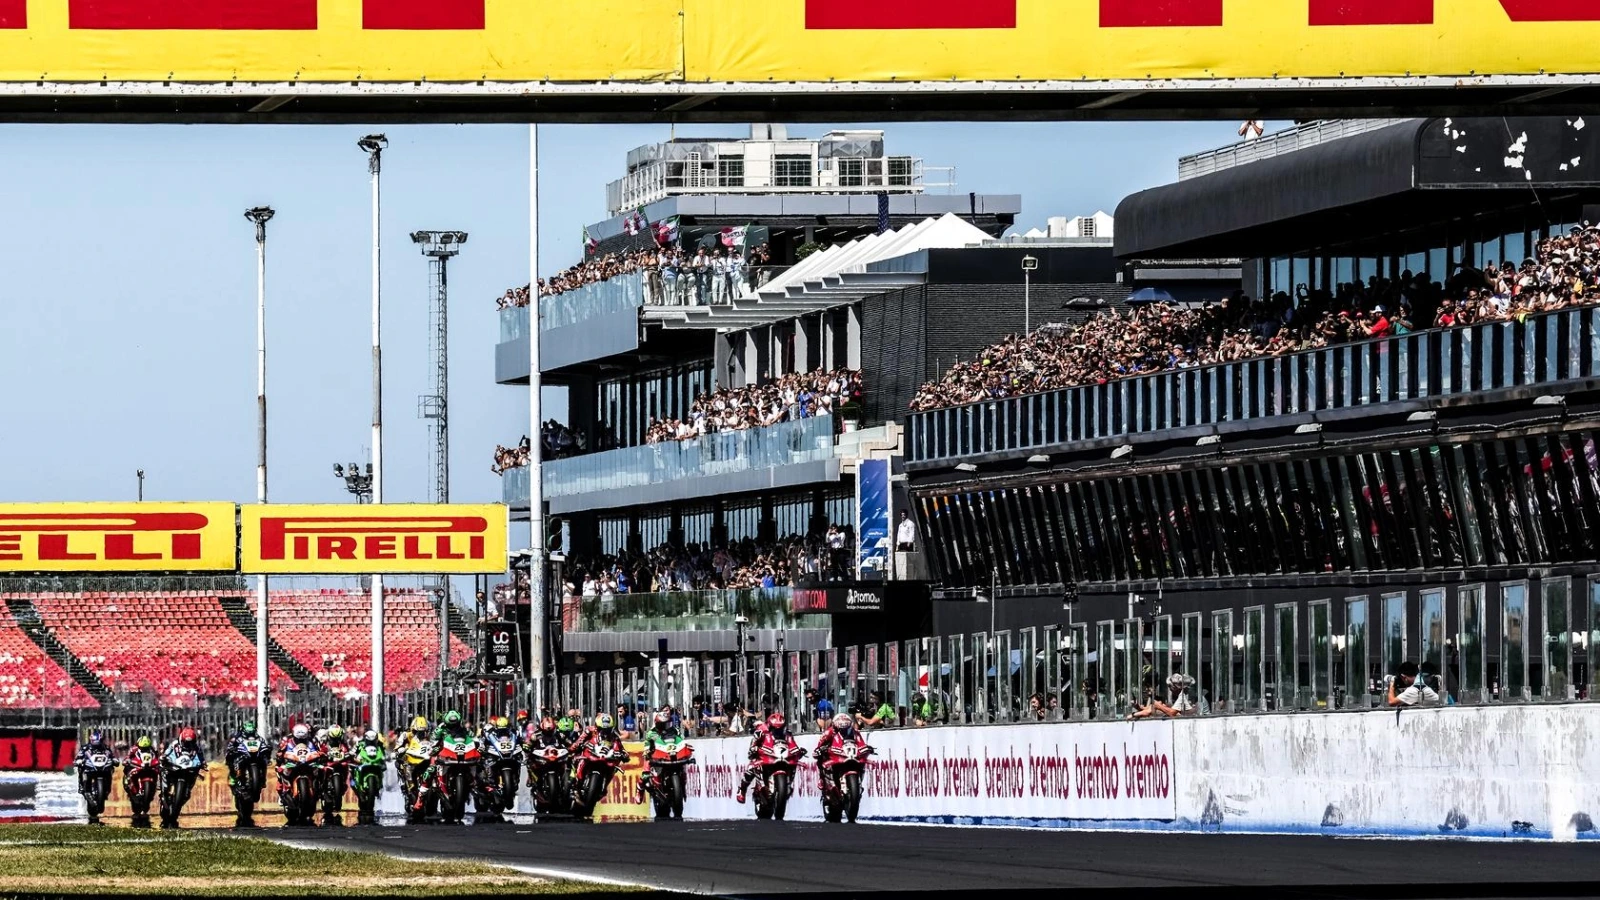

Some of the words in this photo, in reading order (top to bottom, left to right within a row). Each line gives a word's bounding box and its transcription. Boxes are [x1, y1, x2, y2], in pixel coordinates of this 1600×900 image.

[260, 516, 488, 559] PIRELLI
[500, 742, 512, 750] 55
[904, 746, 939, 798] brembo
[943, 745, 979, 797] brembo
[985, 745, 1024, 798] brembo
[1029, 743, 1070, 799] brembo
[1075, 742, 1119, 799] brembo
[1124, 741, 1169, 799] brembo
